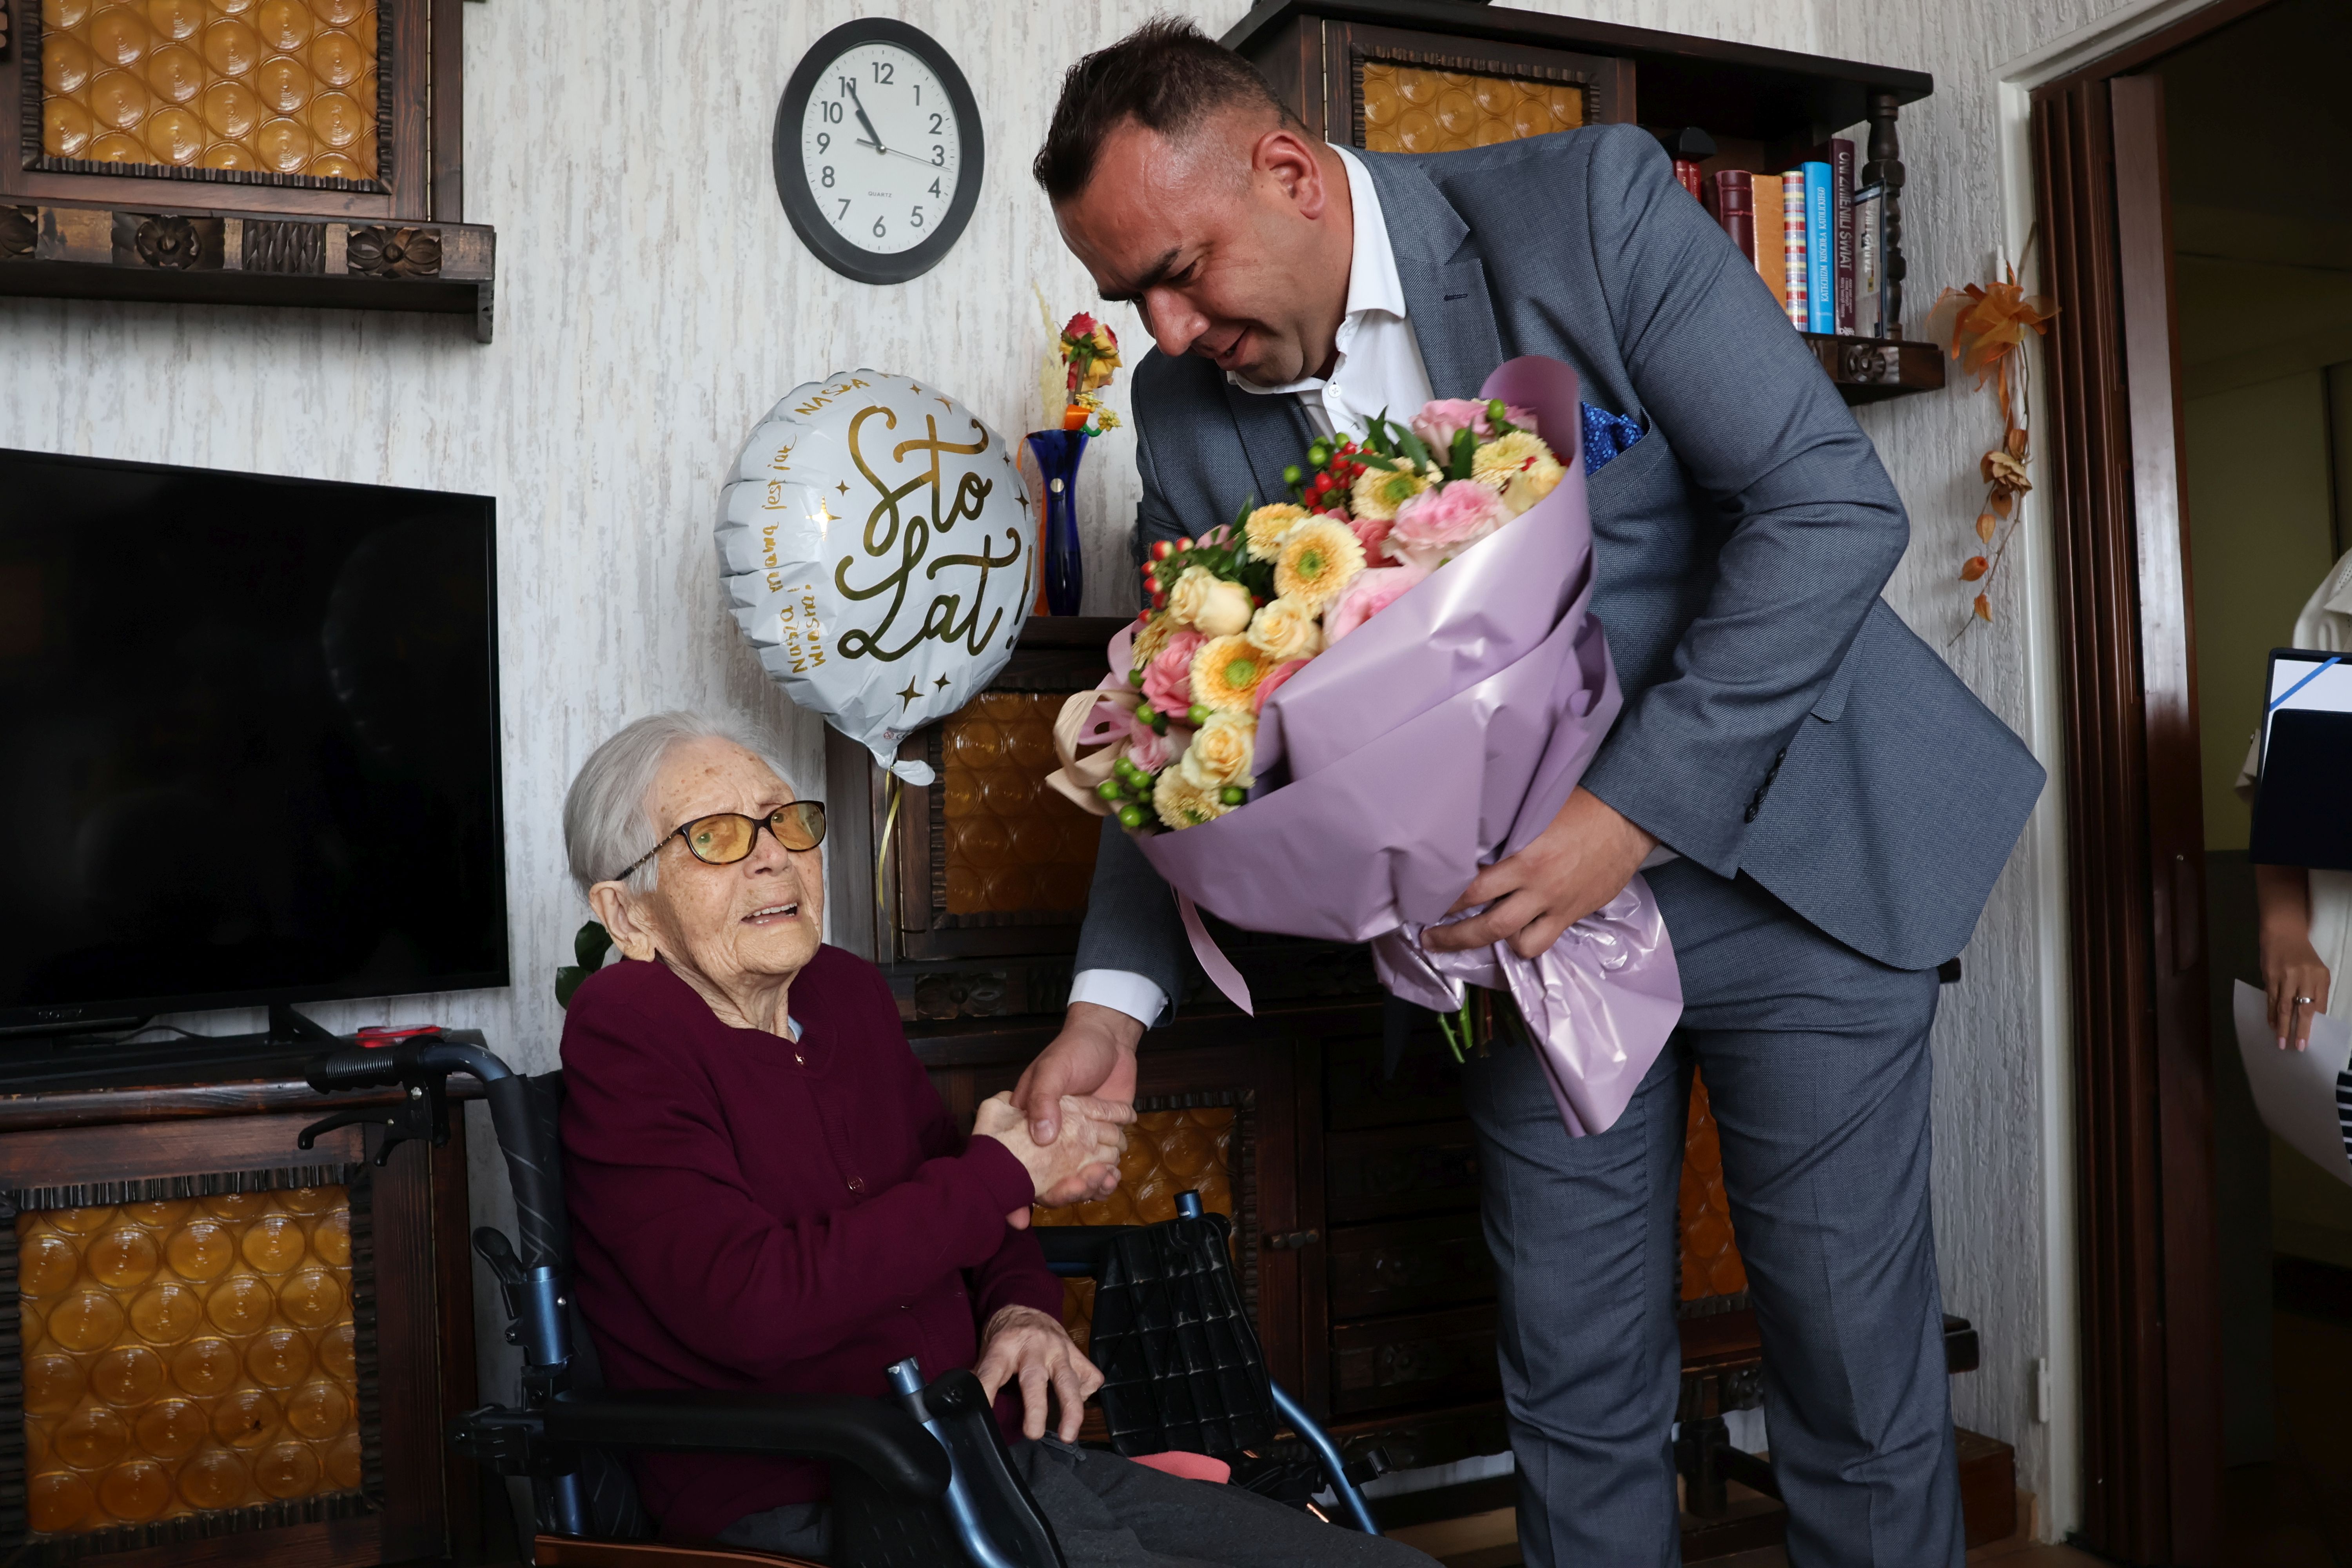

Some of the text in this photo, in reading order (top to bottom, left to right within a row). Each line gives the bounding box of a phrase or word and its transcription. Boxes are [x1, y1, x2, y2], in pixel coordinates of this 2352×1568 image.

[871, 62, 894, 85] 12
[838, 76, 857, 99] 11
[913, 85, 920, 106] 1
[820, 100, 843, 124] 10
[928, 113, 943, 135] 2
[817, 132, 831, 155] 9
[931, 145, 945, 167] 3
[821, 165, 835, 188] 8
[928, 176, 941, 198] 4
[838, 198, 851, 220] 7
[910, 205, 924, 227] 5
[1817, 187, 1827, 229] KATOLICKIEGO
[1839, 152, 1853, 271] ONI ZMIENILI ŚWIAT
[872, 215, 886, 238] 6
[1819, 232, 1828, 262] KOŚCIOŁA
[1820, 265, 1829, 301] KATECHIZM
[848, 405, 993, 557] Sto
[780, 605, 808, 674] Nasza
